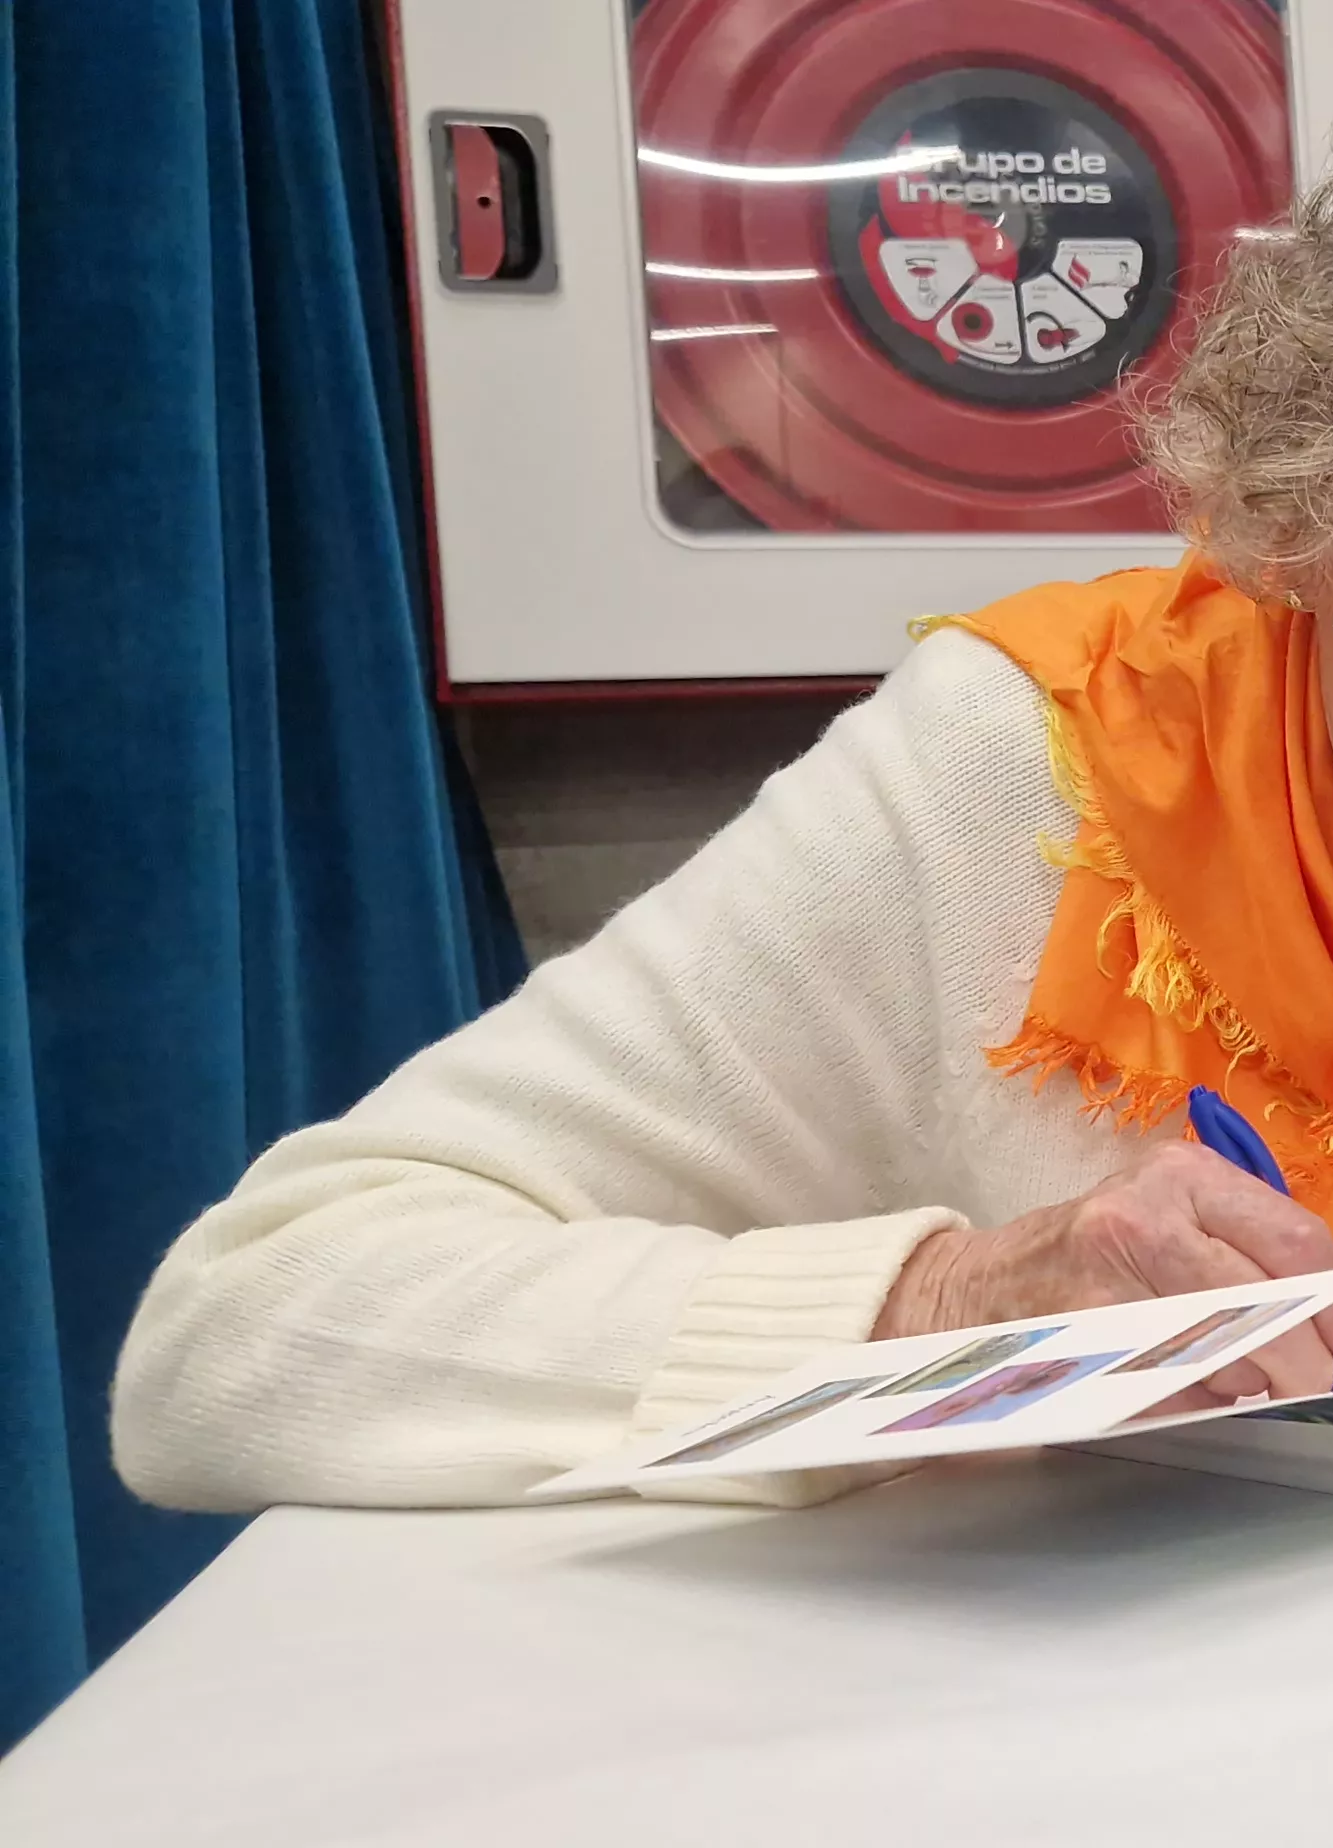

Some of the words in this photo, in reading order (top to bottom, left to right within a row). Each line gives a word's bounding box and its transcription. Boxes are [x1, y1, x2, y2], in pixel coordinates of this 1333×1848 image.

[898, 150, 1045, 179] rupo
[1053, 147, 1107, 175] de
[897, 176, 1112, 204] Incendios
